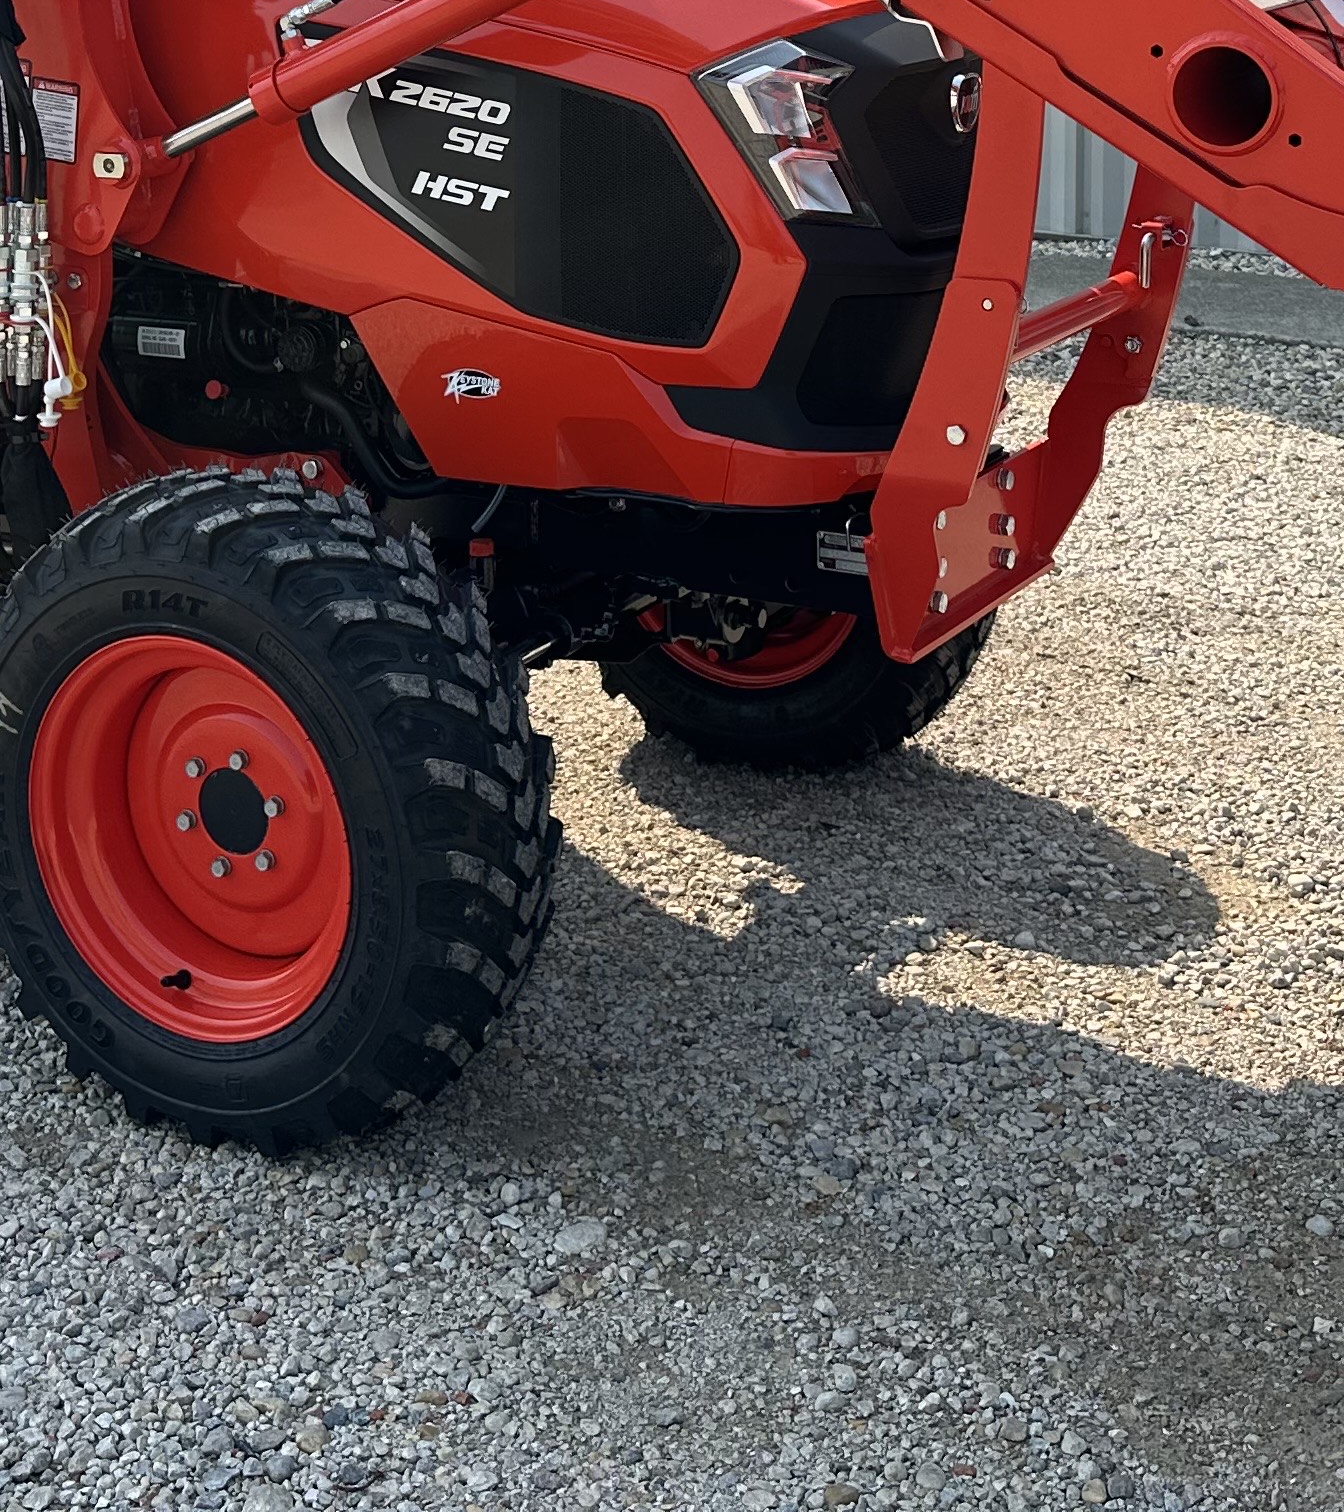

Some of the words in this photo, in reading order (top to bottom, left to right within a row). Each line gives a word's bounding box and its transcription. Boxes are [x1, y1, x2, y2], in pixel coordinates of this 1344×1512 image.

[443, 126, 510, 161] SE
[411, 170, 510, 211] HST
[122, 589, 209, 618] R14T
